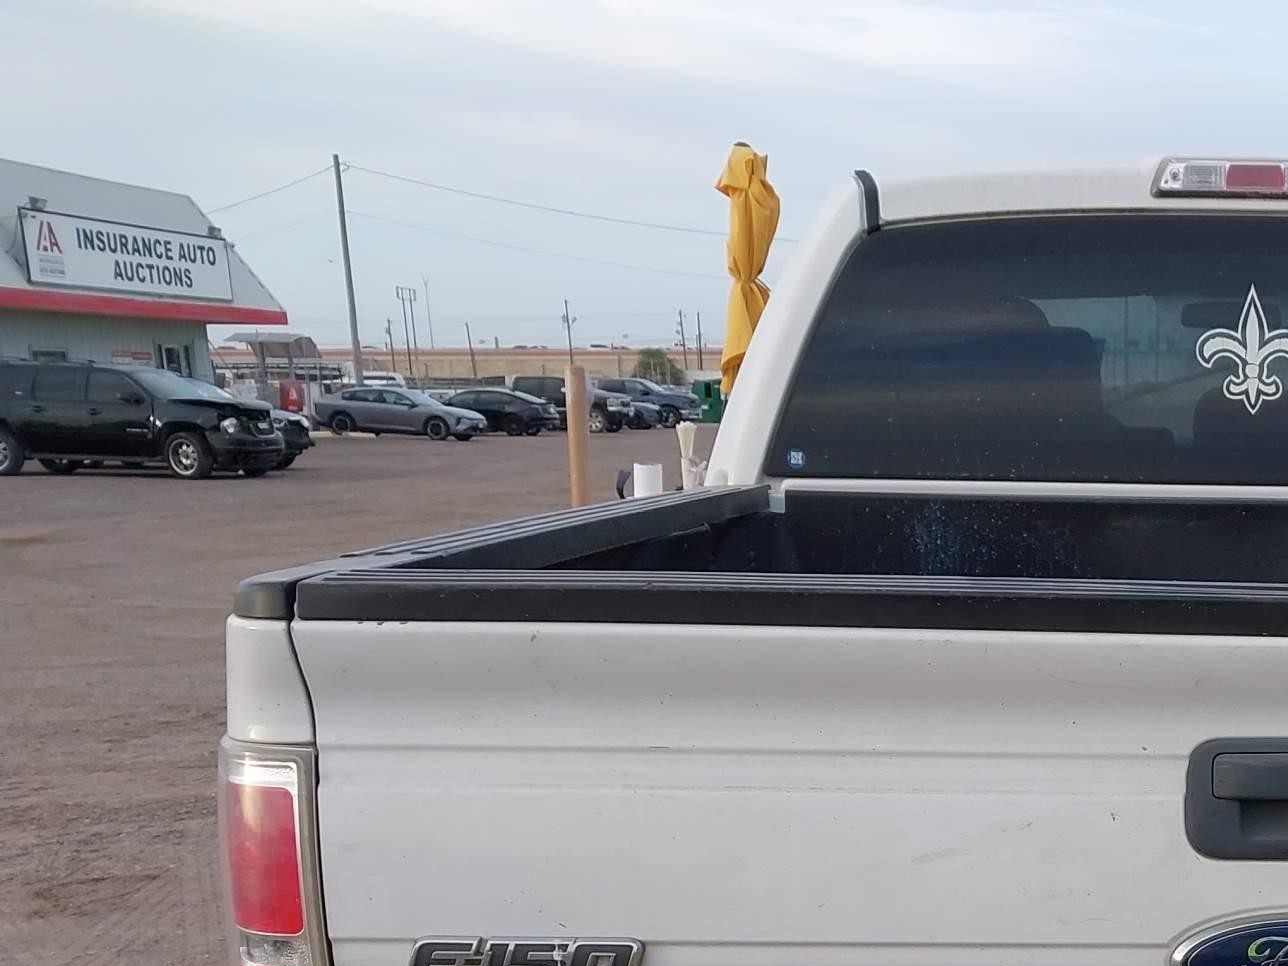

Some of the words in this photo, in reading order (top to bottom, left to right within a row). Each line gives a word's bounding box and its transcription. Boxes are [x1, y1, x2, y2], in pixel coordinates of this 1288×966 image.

[75, 226, 174, 261] INSURANCE
[178, 242, 217, 267] AUTO
[113, 259, 194, 289] AUCTIONS
